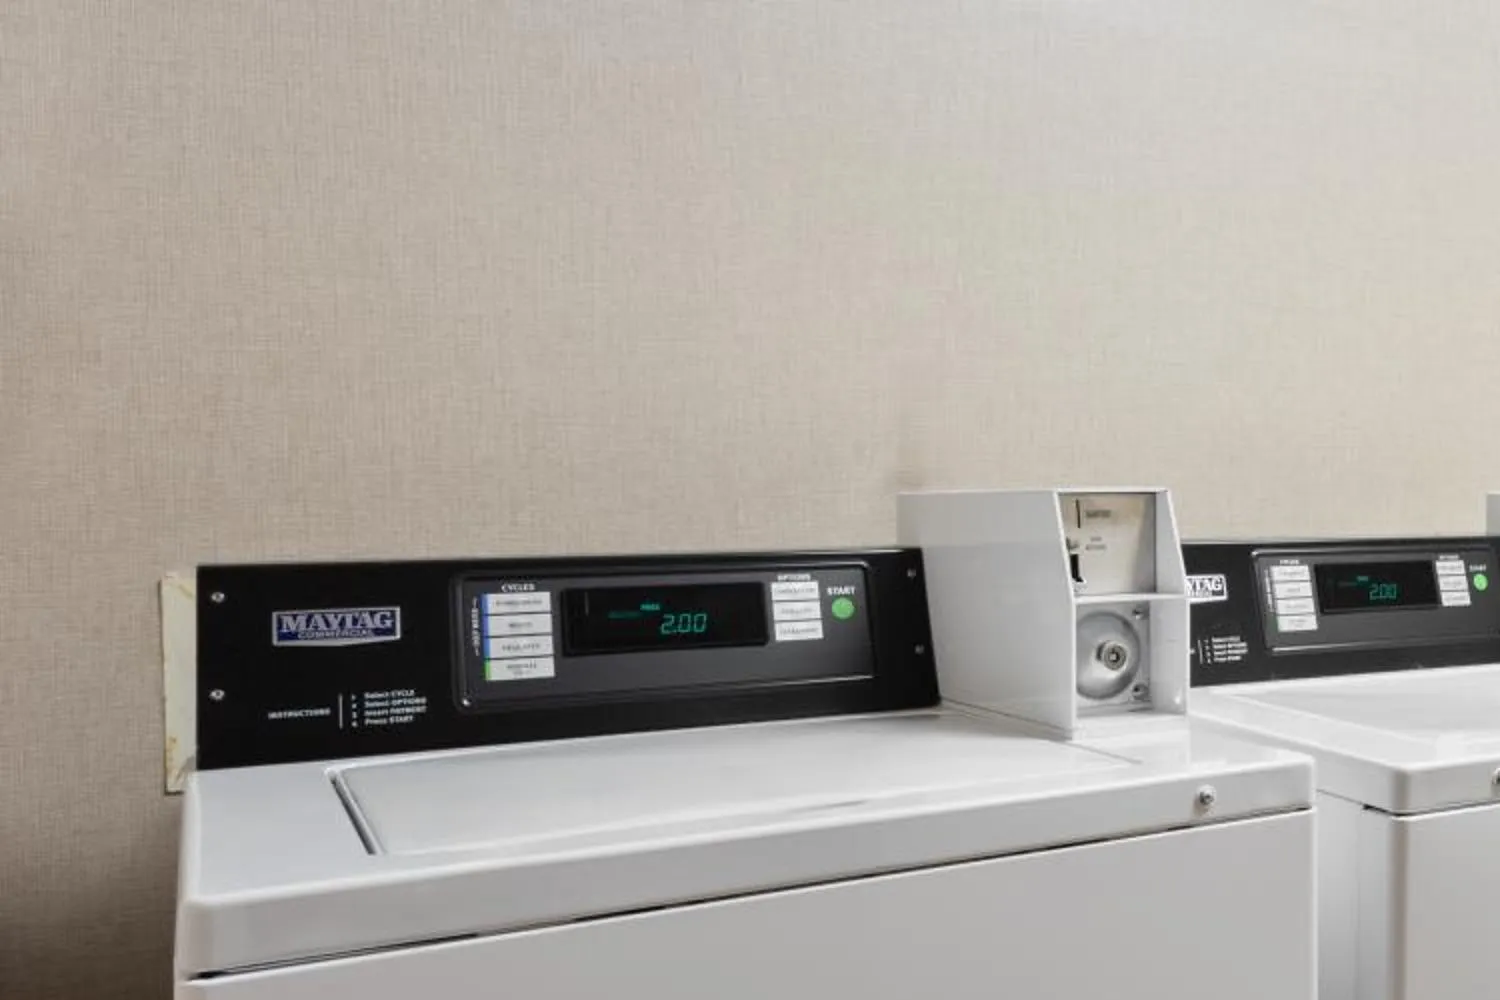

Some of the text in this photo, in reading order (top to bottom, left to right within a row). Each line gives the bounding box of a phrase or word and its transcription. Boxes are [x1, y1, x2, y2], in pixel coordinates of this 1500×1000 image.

[827, 586, 856, 596] START
[281, 611, 393, 632] MAYTAG
[661, 613, 707, 634] 2.00
